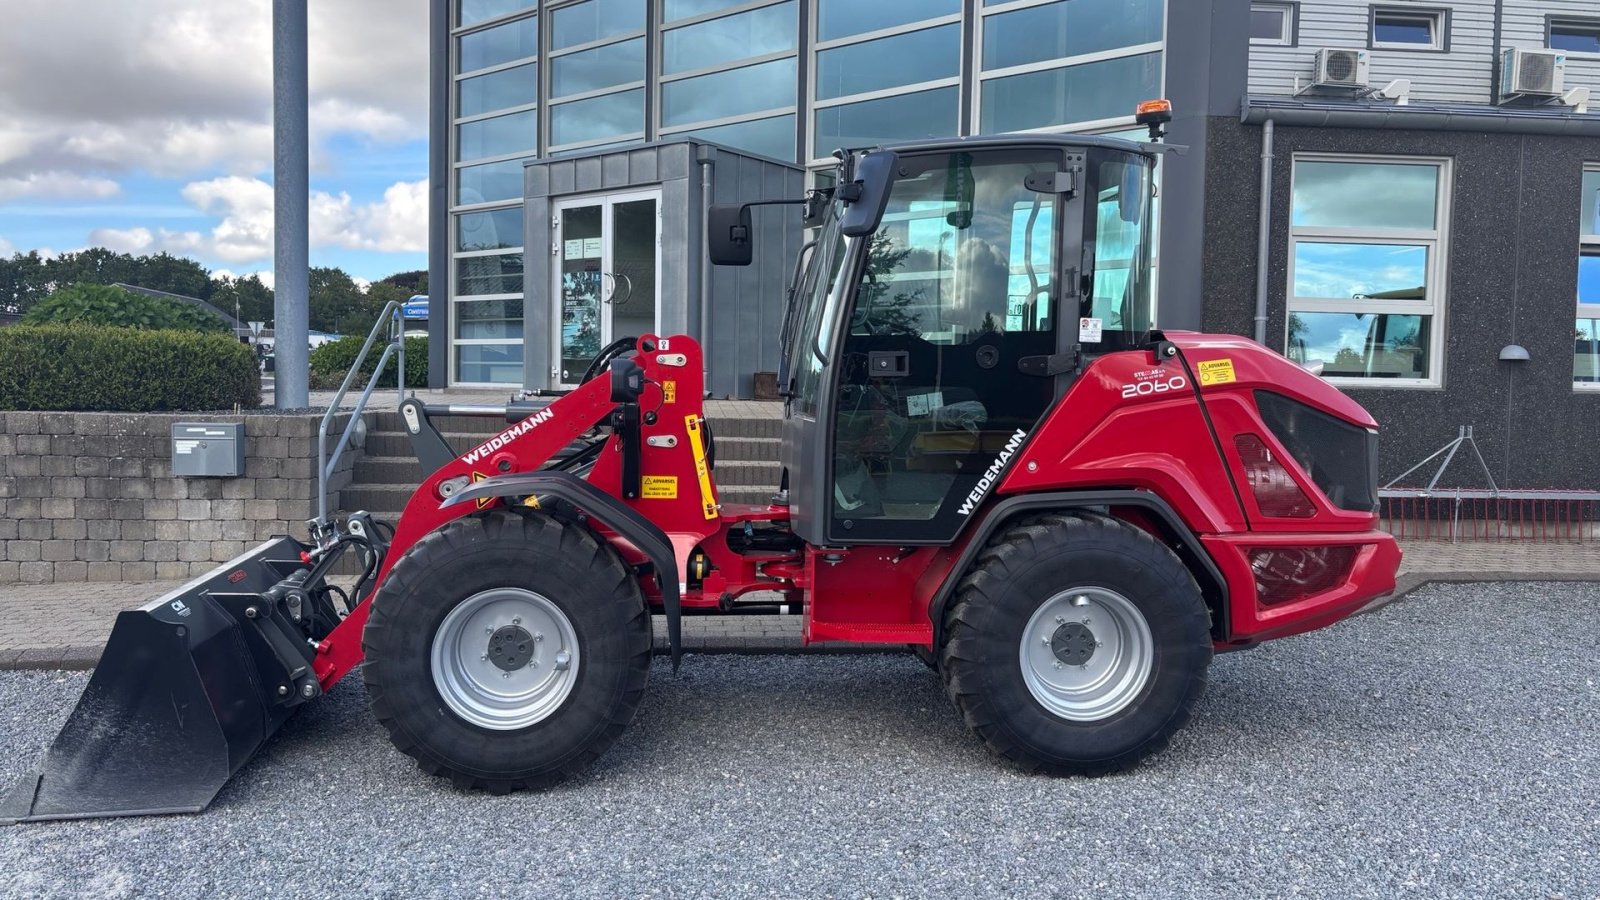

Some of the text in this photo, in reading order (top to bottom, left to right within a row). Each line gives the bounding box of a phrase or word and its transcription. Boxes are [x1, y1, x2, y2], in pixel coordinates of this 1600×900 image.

[1121, 376, 1186, 399] 2060
[461, 407, 555, 466] WEIDEMANN
[956, 428, 1027, 516] WEIDEMANN
